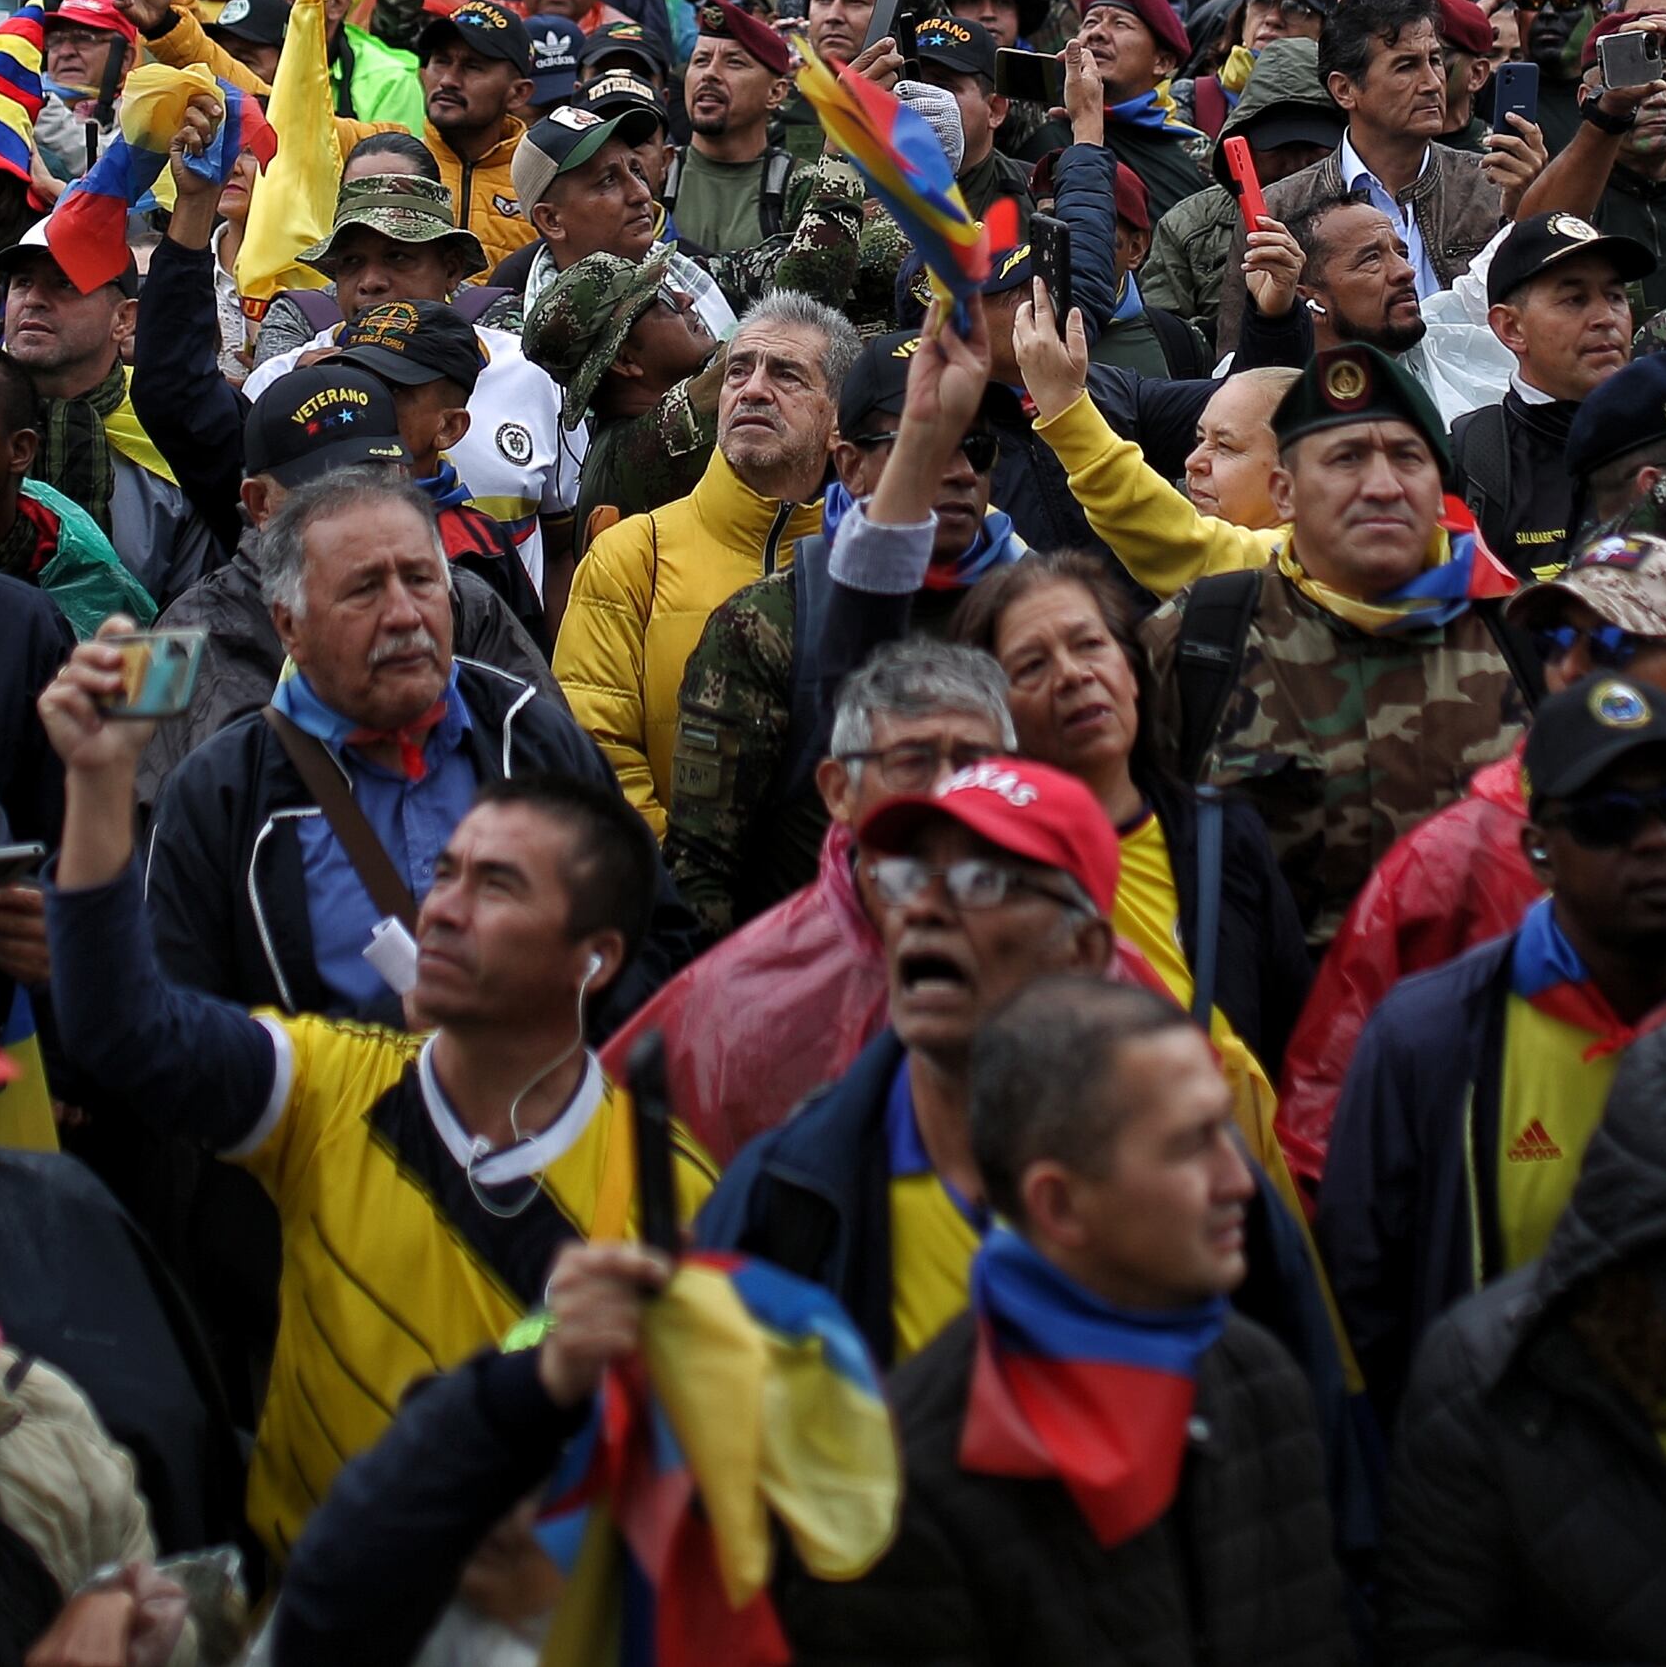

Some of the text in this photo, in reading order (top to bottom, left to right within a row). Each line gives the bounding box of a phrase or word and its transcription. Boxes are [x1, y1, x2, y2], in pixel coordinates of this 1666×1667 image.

[915, 18, 971, 43] TERANO
[535, 55, 576, 69] adidas
[891, 337, 923, 359] VET
[291, 388, 369, 424] VETERANO
[1507, 1146, 1564, 1162] adidas
